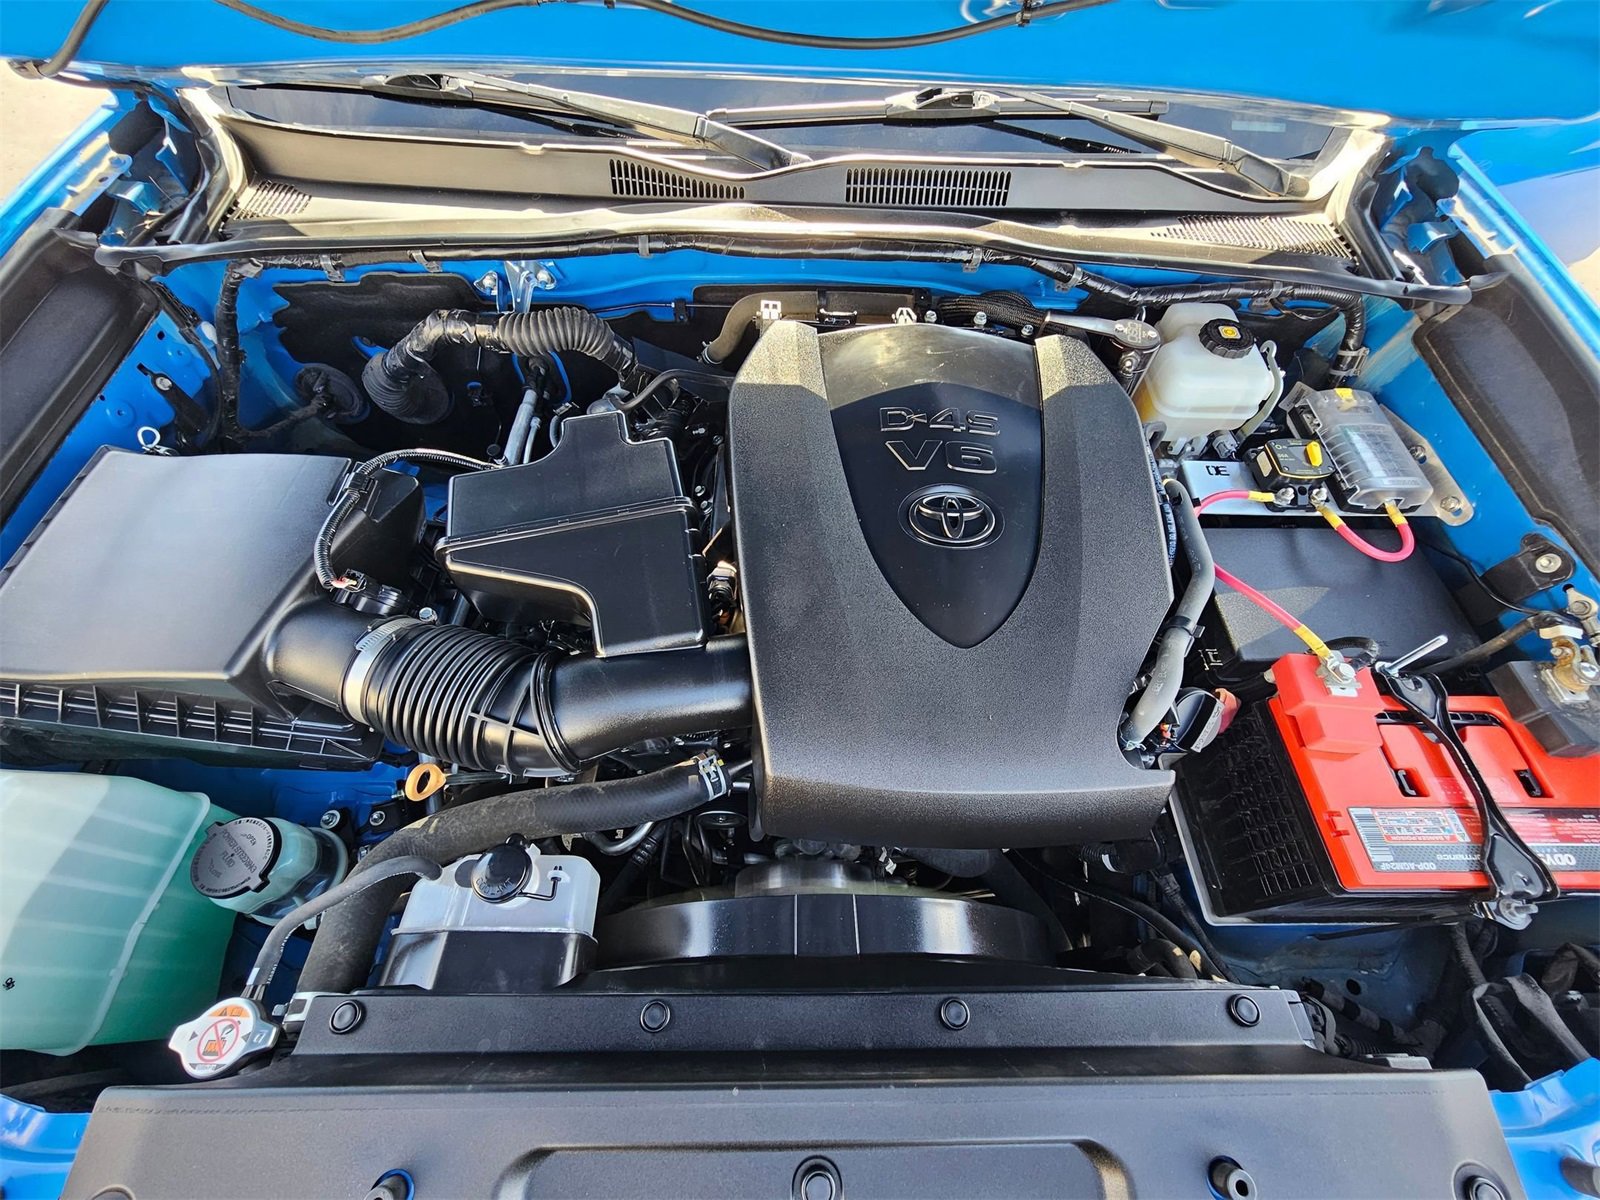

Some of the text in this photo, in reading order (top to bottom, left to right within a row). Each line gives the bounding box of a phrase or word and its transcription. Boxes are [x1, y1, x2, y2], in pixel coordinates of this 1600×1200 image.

[885, 440, 997, 474] V6
[221, 829, 258, 873] POWER STEERING
[245, 833, 257, 846] OPEN
[221, 850, 236, 868] FLUID
